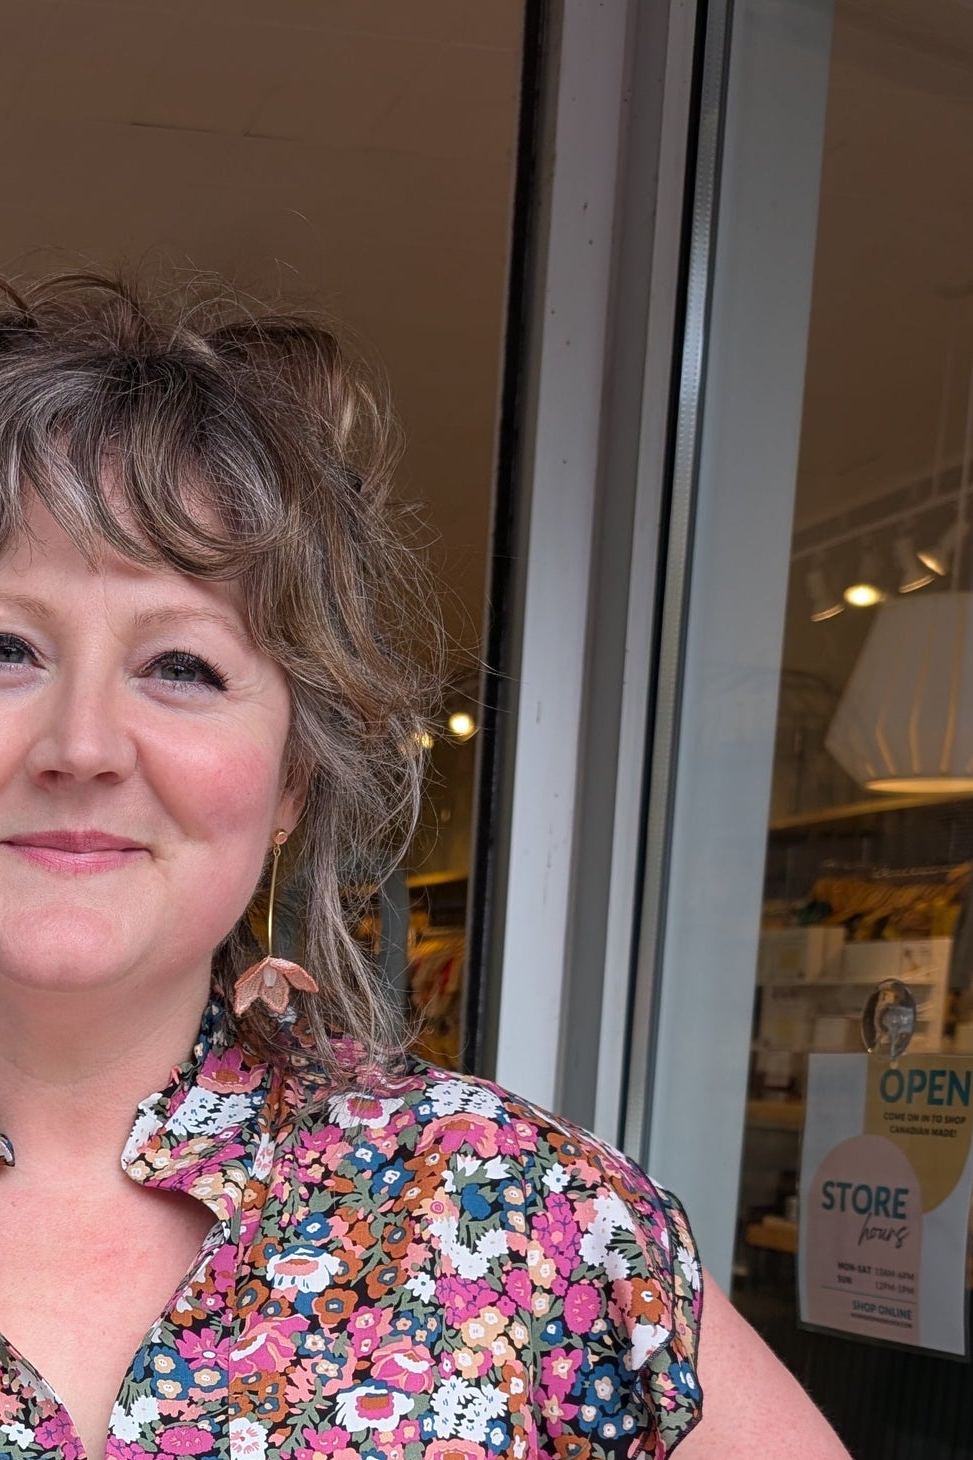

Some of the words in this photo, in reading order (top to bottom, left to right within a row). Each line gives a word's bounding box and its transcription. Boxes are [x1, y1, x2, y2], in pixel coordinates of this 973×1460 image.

[880, 1068, 971, 1106] OPEN
[883, 1111, 905, 1122] COME
[907, 1113, 919, 1122] ON
[921, 1114, 930, 1123] IN
[932, 1114, 943, 1124] TO
[945, 1115, 967, 1125] SHOP
[889, 1125, 930, 1136] CANADIAN
[932, 1128, 957, 1138] MADE!
[821, 1180, 909, 1220] STORE
[858, 1211, 911, 1249] hours
[852, 1299, 876, 1313] SHOP
[878, 1304, 913, 1321] ONLINE
